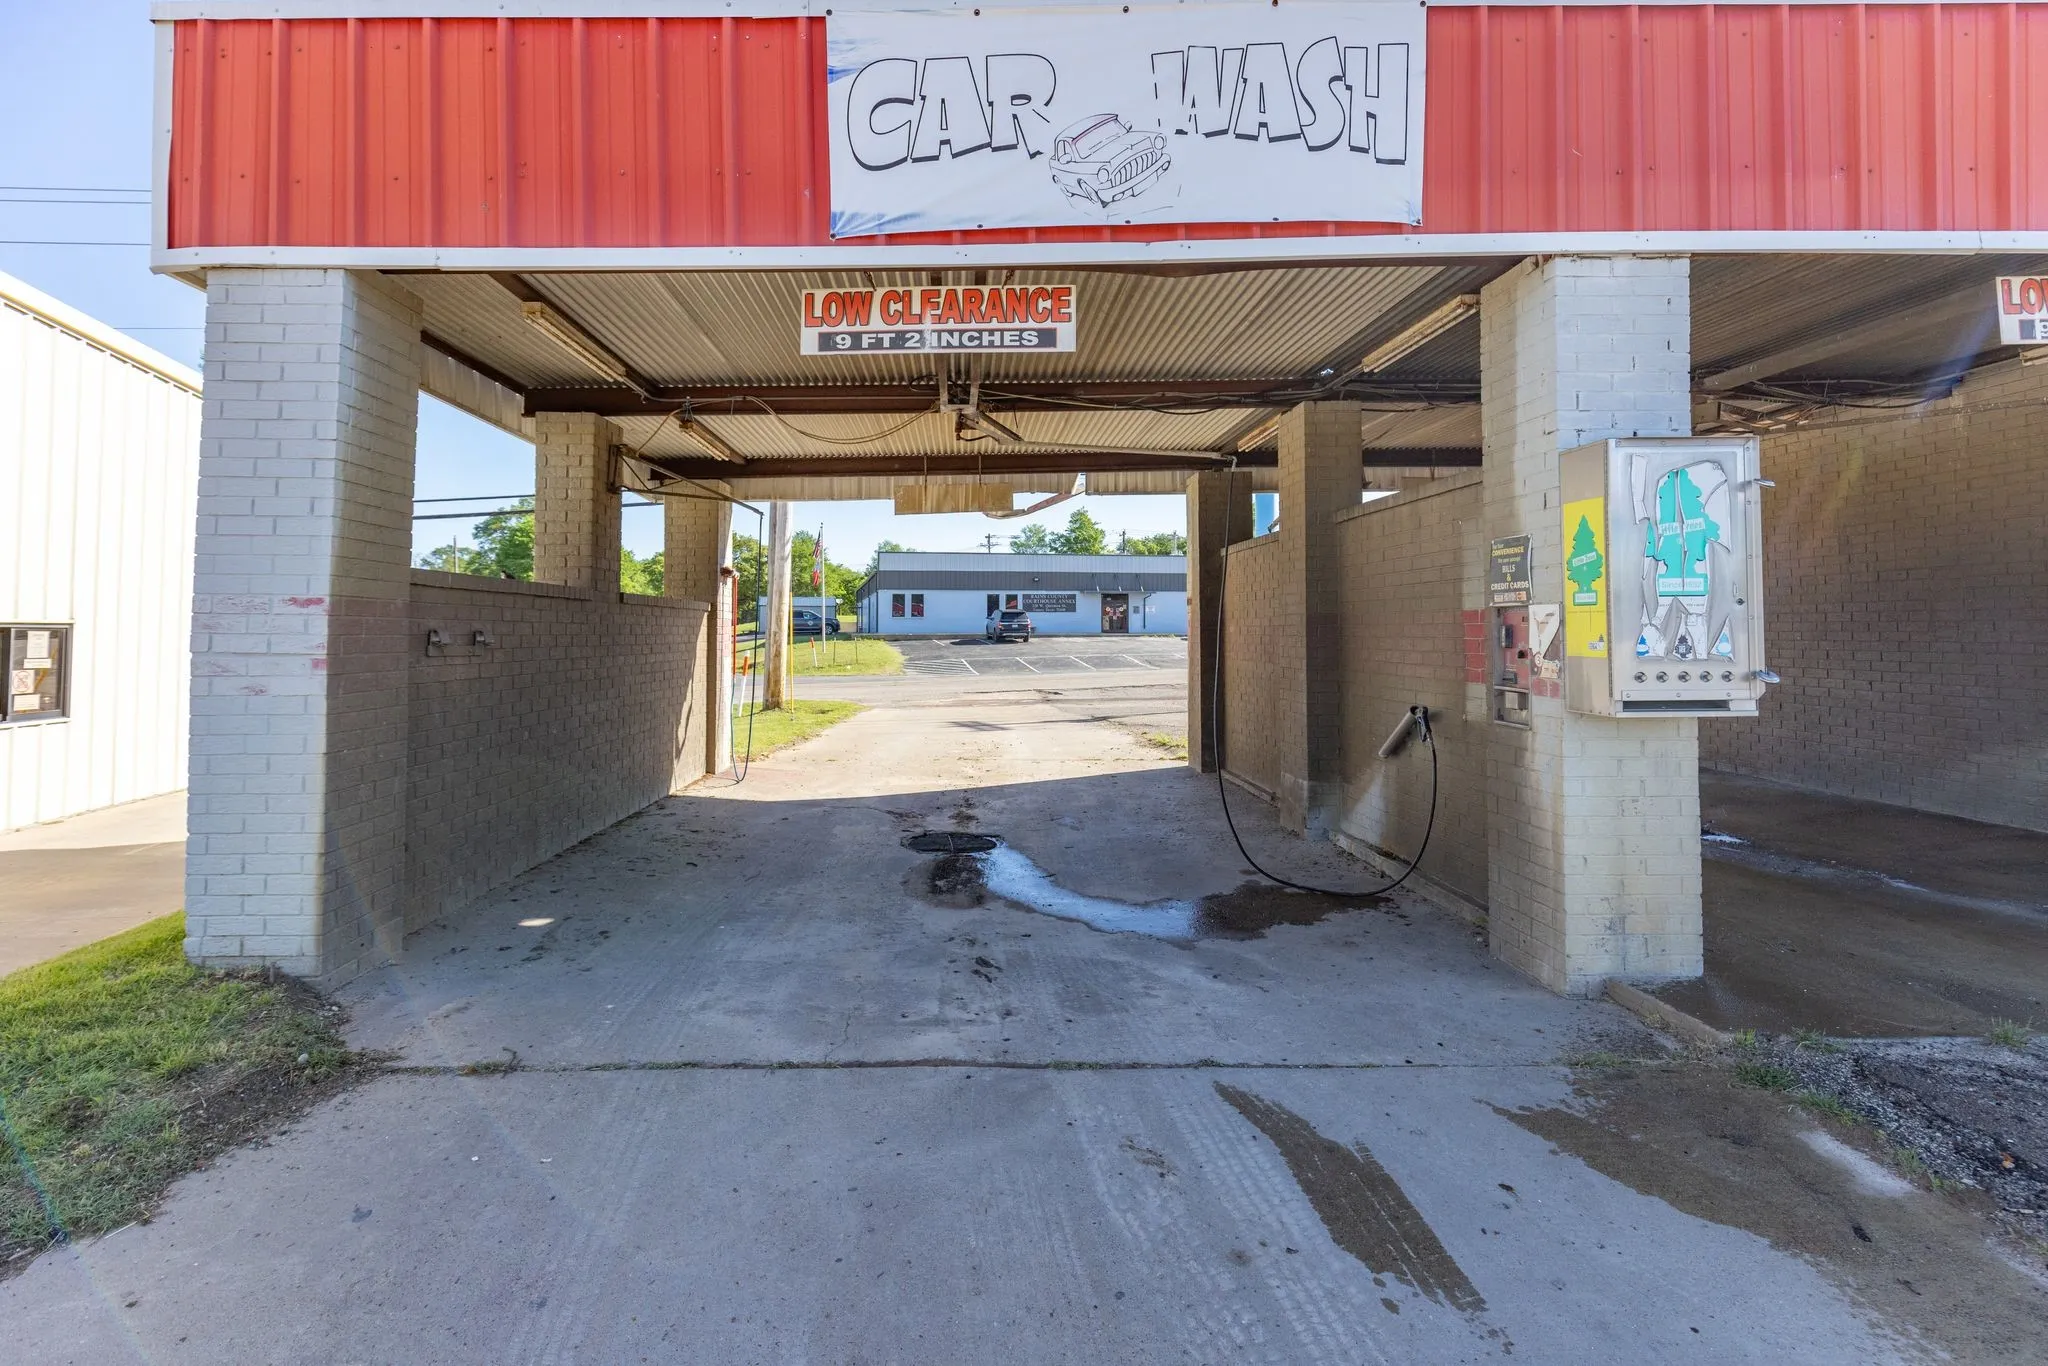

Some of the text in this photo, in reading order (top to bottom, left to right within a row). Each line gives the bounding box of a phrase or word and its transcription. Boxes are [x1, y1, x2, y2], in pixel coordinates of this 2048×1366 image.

[848, 37, 1409, 171] CAR WASH
[2001, 278, 2048, 315] LO
[804, 287, 1072, 327] LOW CLEARANCE
[835, 330, 1039, 349] 9 FT 2 INCHES
[1492, 546, 1524, 557] CONVENIENCE
[1502, 564, 1516, 573] BILLS
[1506, 573, 1511, 582] &
[1491, 580, 1529, 591] CREDIT CARDS
